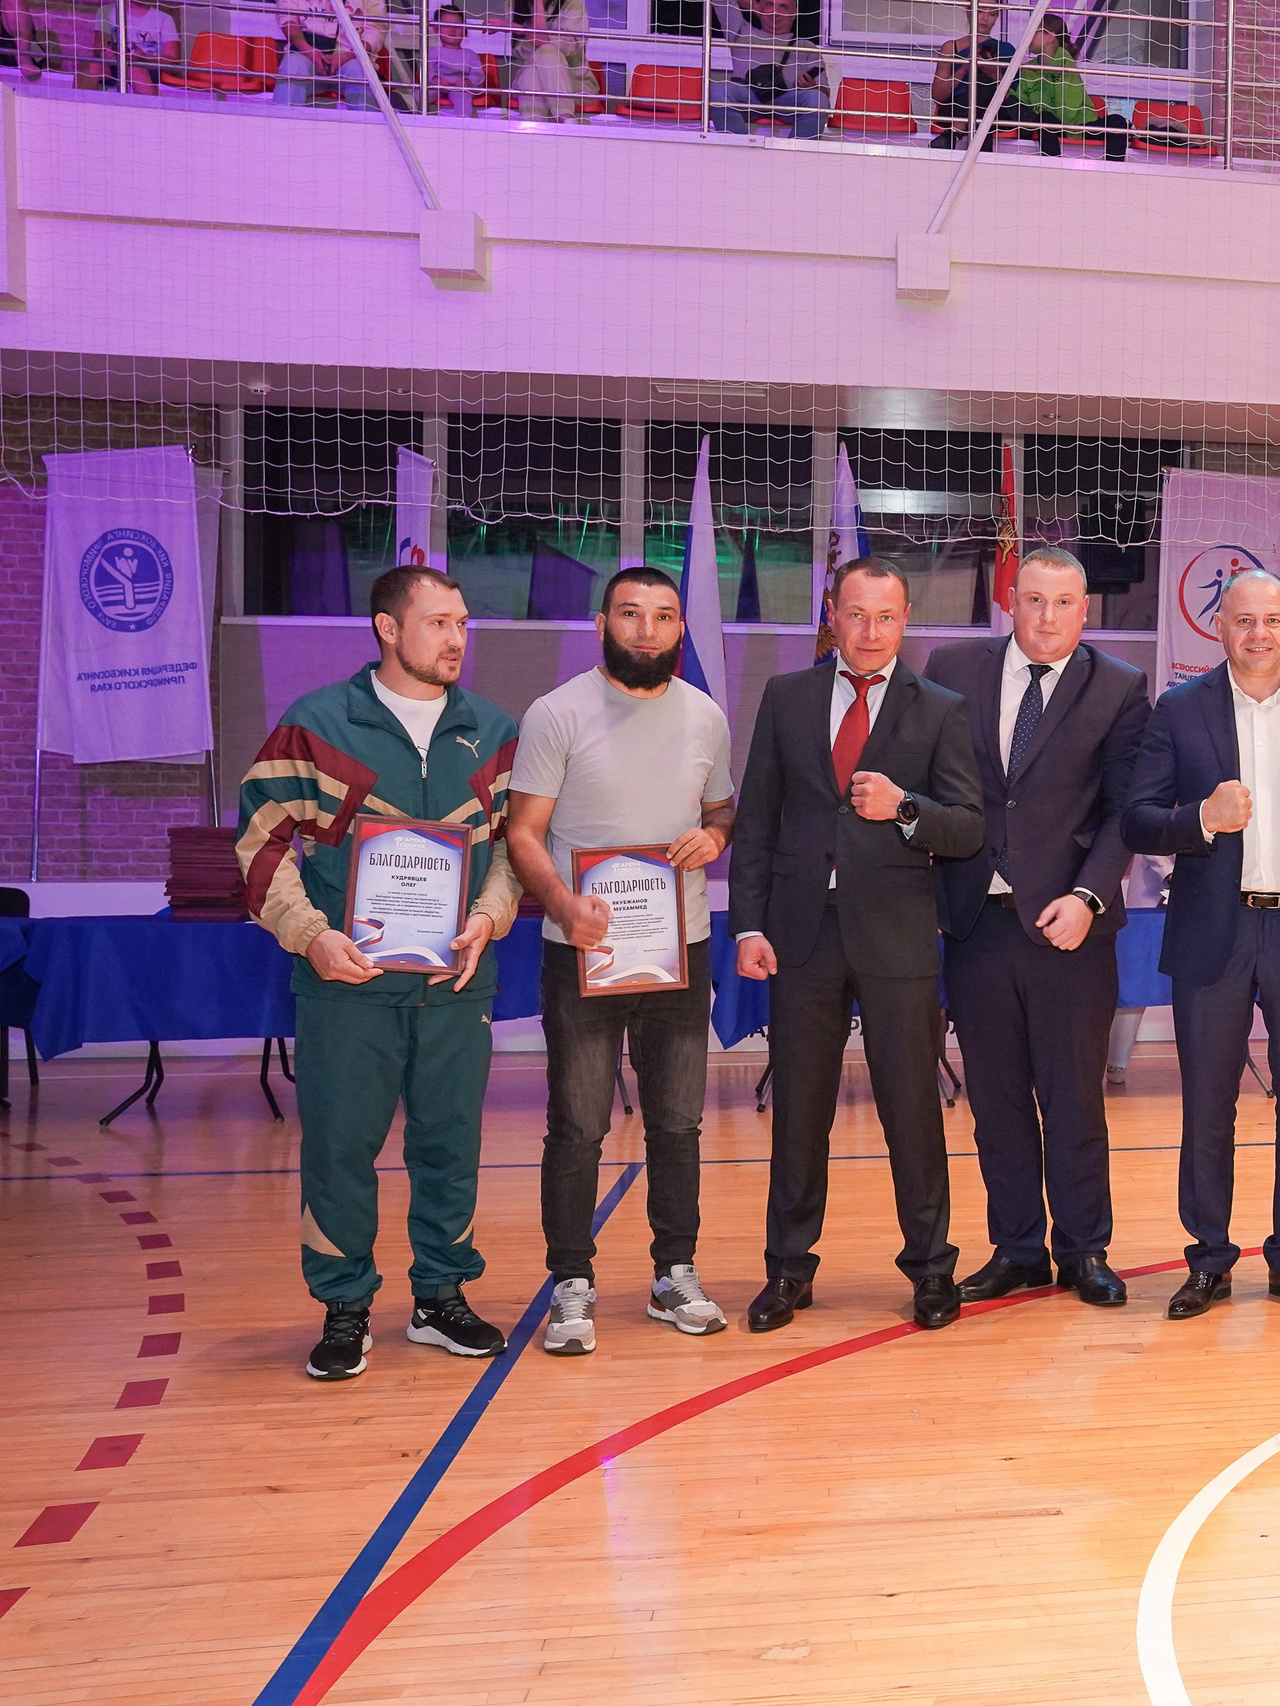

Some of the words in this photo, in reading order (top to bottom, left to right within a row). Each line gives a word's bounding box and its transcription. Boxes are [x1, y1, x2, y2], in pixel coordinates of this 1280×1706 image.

[369, 852, 451, 872] БЛАГОДАРНОСТЬ
[391, 874, 428, 882] КУДРЯВЦЕВ
[591, 877, 667, 895] БЛАГОДАРНОСТЬ
[612, 898, 648, 906] ЯКУБЖАНОВ
[613, 904, 648, 912] МУХАММЕД
